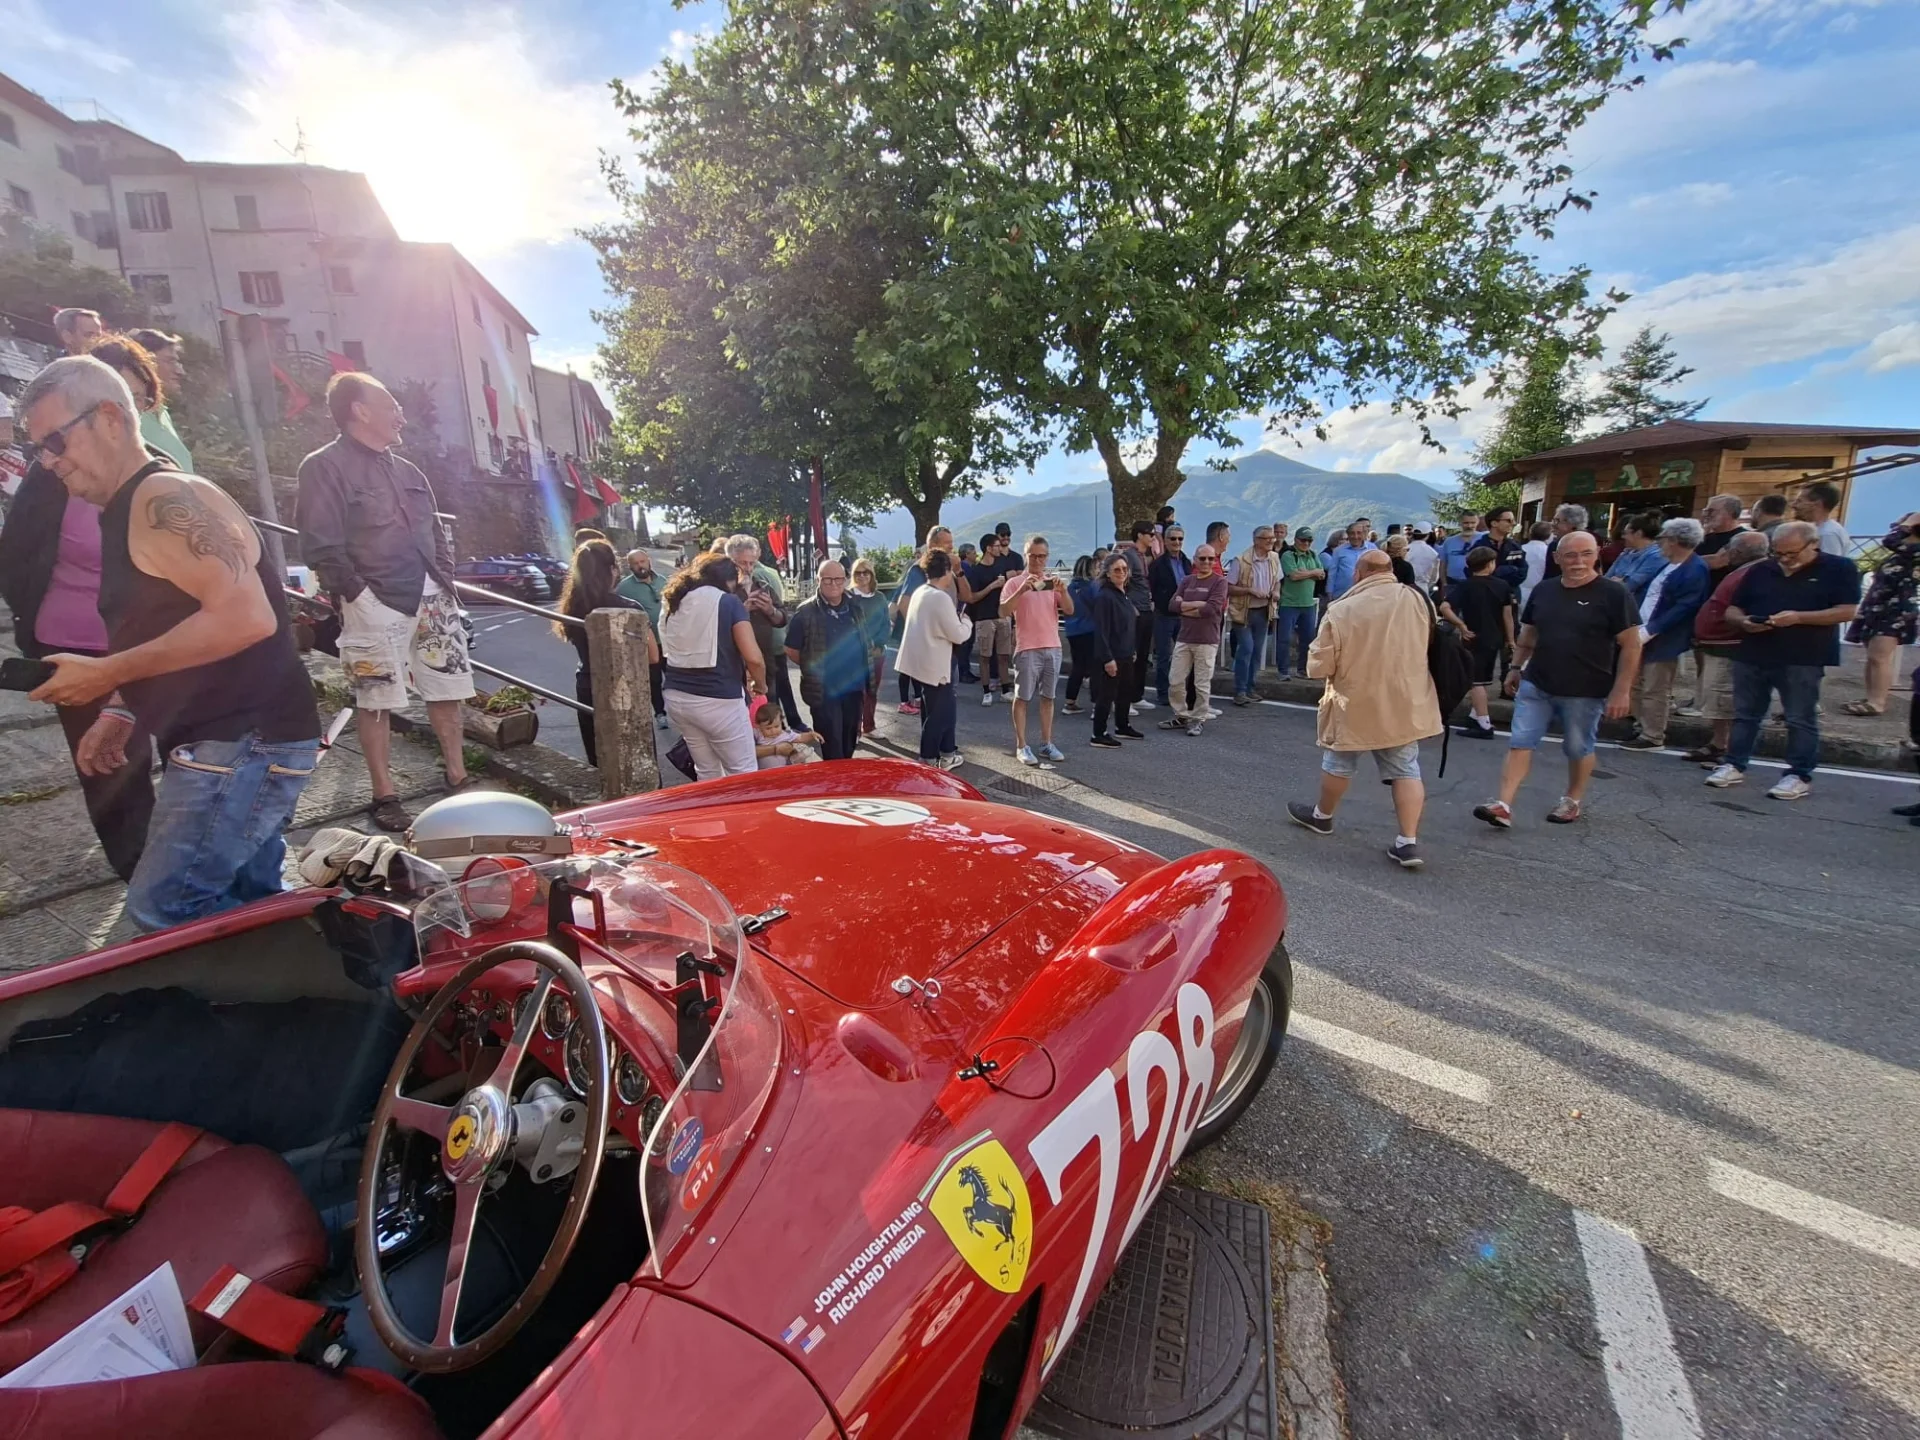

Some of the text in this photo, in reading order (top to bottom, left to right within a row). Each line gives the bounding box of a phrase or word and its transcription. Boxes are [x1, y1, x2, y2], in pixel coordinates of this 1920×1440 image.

[692, 1161, 714, 1199] P11
[1028, 982, 1215, 1382] 728
[813, 1201, 923, 1313] JOHN HOUGHTALING
[828, 1224, 926, 1325] RICHARD PINEDA
[999, 1264, 1010, 1284] S
[1153, 1231, 1191, 1384] FOGNATURA
